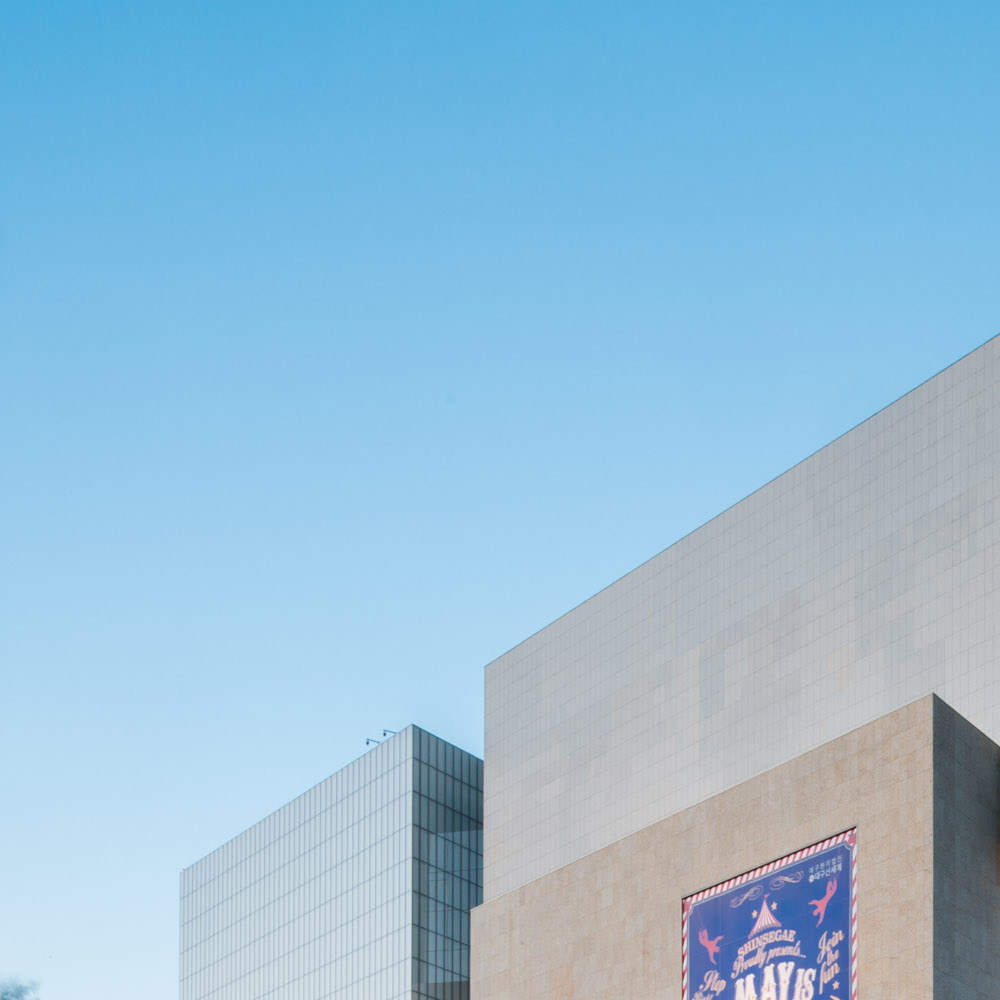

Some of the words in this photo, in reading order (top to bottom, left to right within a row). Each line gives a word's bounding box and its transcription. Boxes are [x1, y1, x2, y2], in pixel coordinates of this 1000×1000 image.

[738, 929, 796, 955] SHINSEGAE
[816, 930, 844, 964] Join
[819, 961, 840, 995] fun
